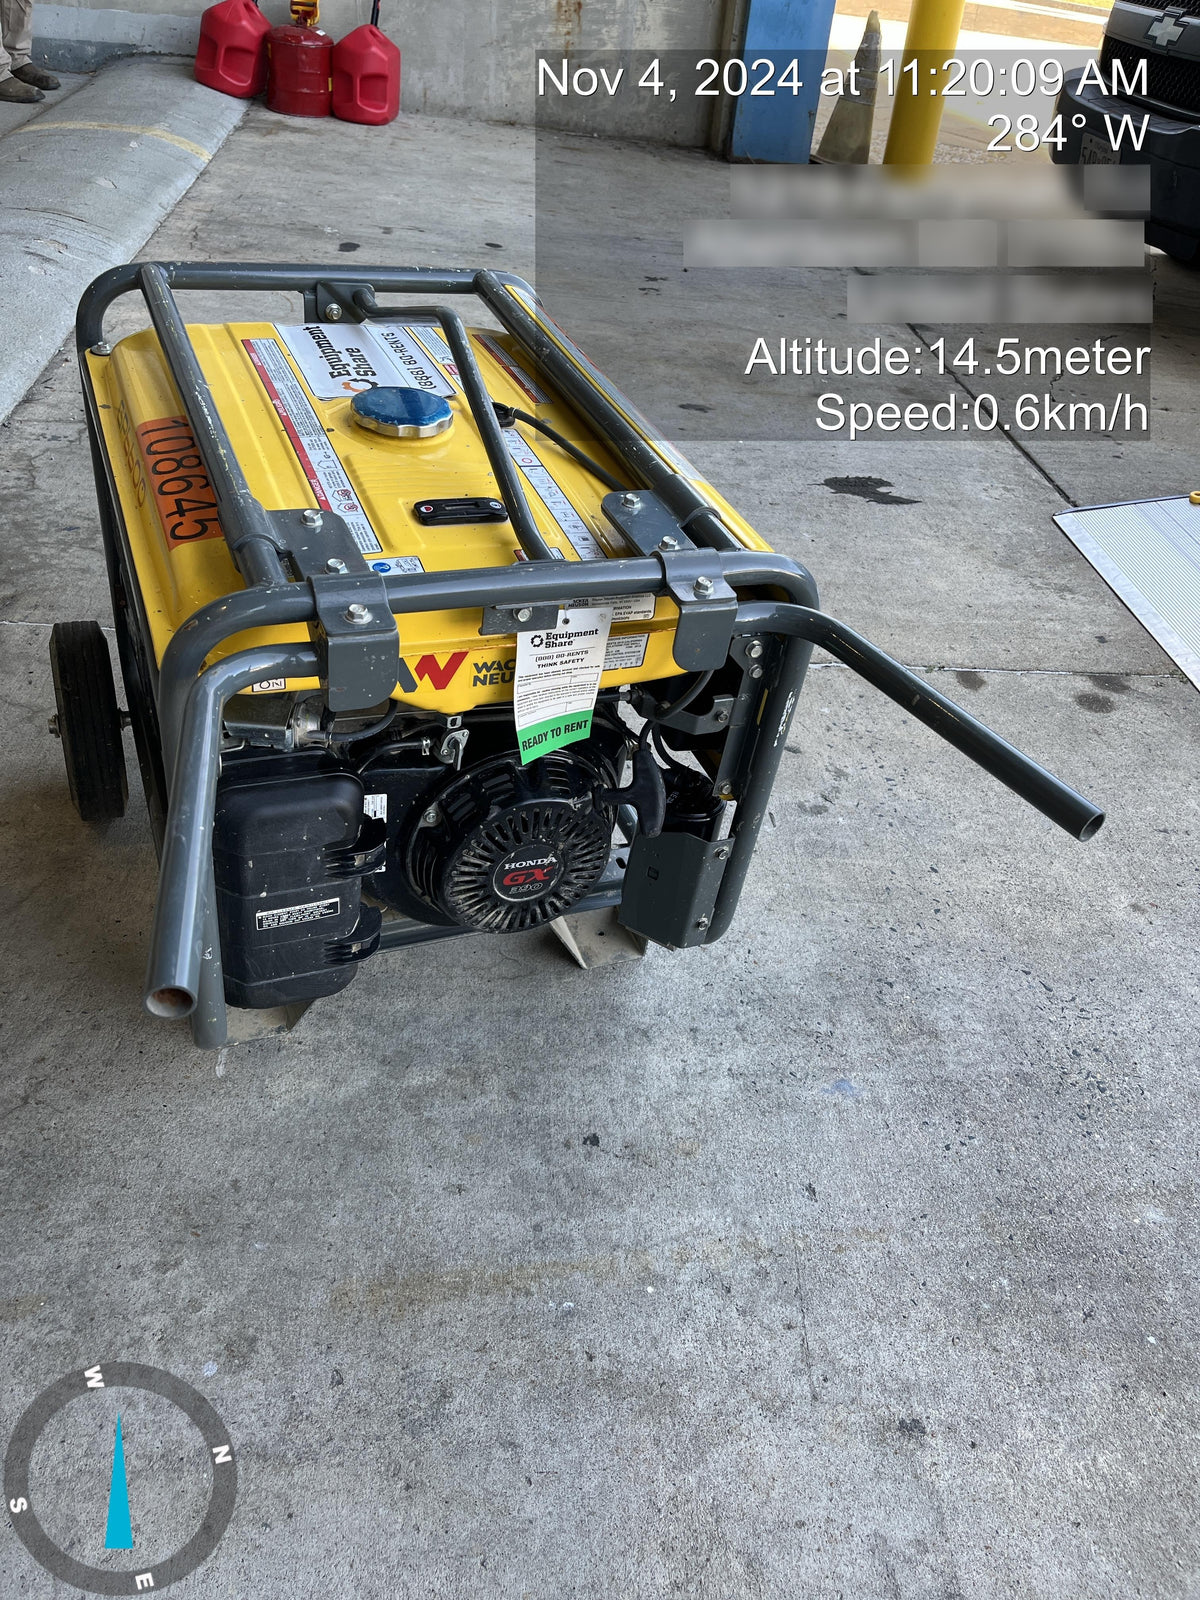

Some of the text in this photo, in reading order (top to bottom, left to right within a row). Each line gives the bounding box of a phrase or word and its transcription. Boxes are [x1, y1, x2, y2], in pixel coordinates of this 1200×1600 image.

[303, 325, 352, 379] Equipment
[141, 419, 219, 540] 108645
[545, 628, 599, 641] Equipment
[545, 639, 573, 649] Share
[472, 658, 517, 675] WAC
[536, 657, 585, 669] THINK SAFETY
[472, 671, 515, 687] NEU
[521, 719, 589, 752] READY TO RENT
[503, 855, 558, 871] HONDA
[502, 865, 554, 886] GX
